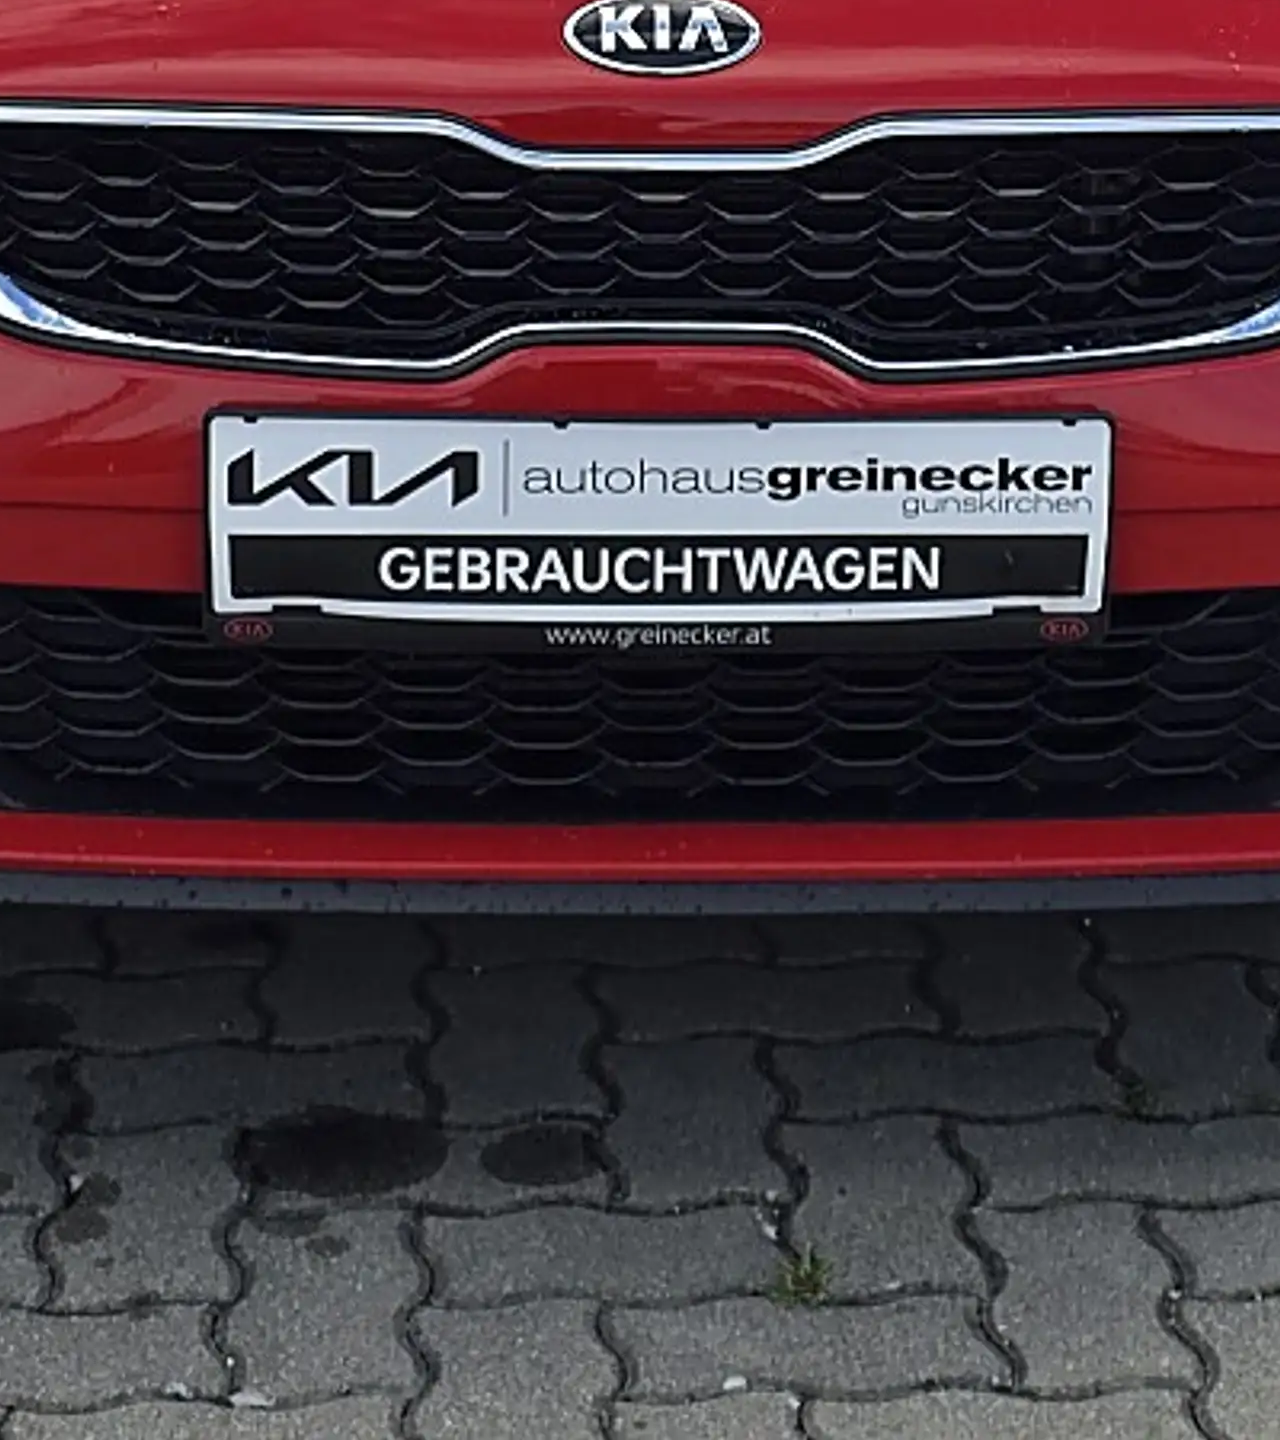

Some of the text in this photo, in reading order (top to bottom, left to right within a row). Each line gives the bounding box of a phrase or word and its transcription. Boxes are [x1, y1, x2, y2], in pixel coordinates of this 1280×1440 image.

[597, 3, 730, 53] KIA
[227, 448, 479, 507] KIA
[901, 492, 1092, 520] gunskirchen
[378, 546, 942, 594] GEBRAUCHTWAGEN
[545, 623, 773, 650] www.greinecker.at
